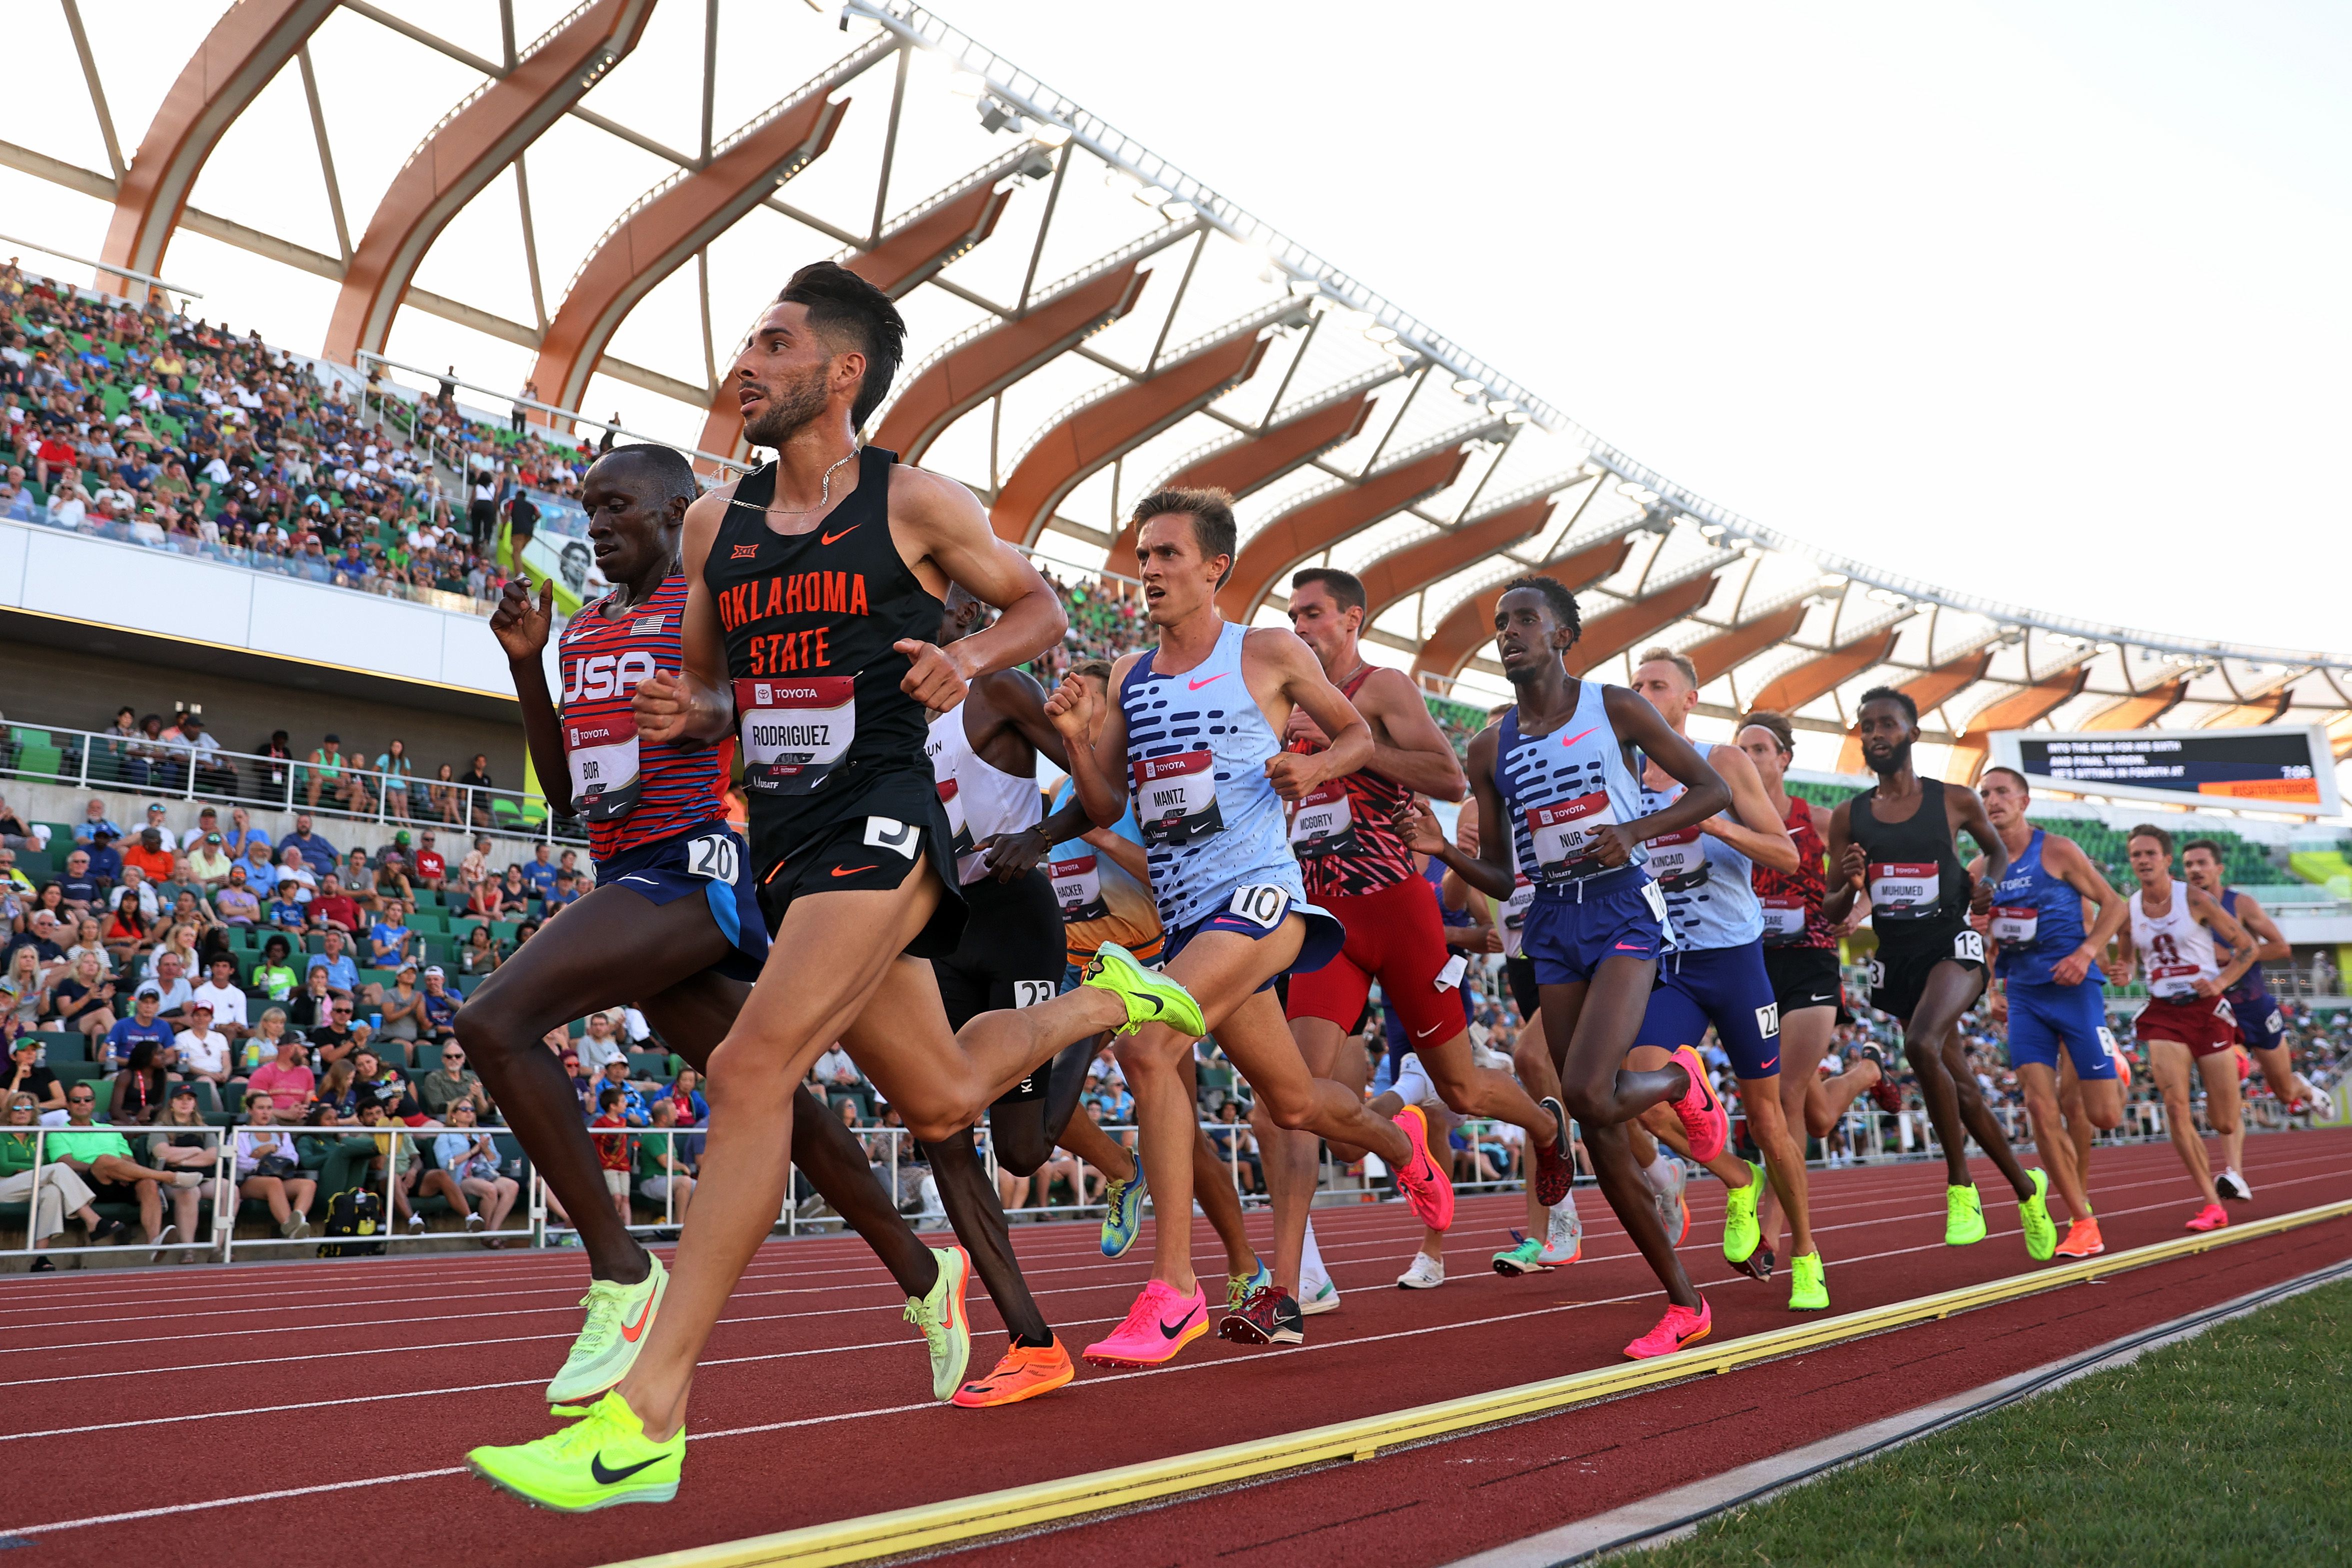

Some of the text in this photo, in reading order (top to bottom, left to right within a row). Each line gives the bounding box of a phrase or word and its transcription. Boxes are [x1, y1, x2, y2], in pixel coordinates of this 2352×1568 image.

[719, 571, 869, 632] OKLAHOMA
[750, 626, 830, 675] STATE
[563, 652, 656, 704] USA
[775, 688, 817, 698] TOYOTA
[580, 728, 609, 740] TOYOTA
[752, 725, 830, 746] RODRIGUEZ
[924, 740, 942, 757] UN
[583, 761, 599, 780] BOR
[1156, 761, 1186, 772] TOYOTA
[1153, 788, 1186, 807] MANTZ
[1307, 792, 1328, 801] TOYOTA
[1553, 804, 1586, 818] TOYOTA
[1300, 813, 1332, 830] MCGORTY
[1559, 831, 1583, 848] NUR
[1657, 834, 1681, 842] TOYOTA
[697, 836, 732, 880] 20
[1651, 853, 1684, 868] KINCAID
[1058, 864, 1079, 873] TOYOTA
[1555, 870, 1571, 878] USATF
[1057, 884, 1084, 898] HACKER
[1881, 886, 1923, 896] MUHUMED
[2000, 876, 2033, 891] FORCE
[1242, 886, 1280, 921] 10
[1957, 934, 1981, 956] 13
[1022, 982, 1051, 1007] 23
[1021, 1074, 1032, 1093] KI
